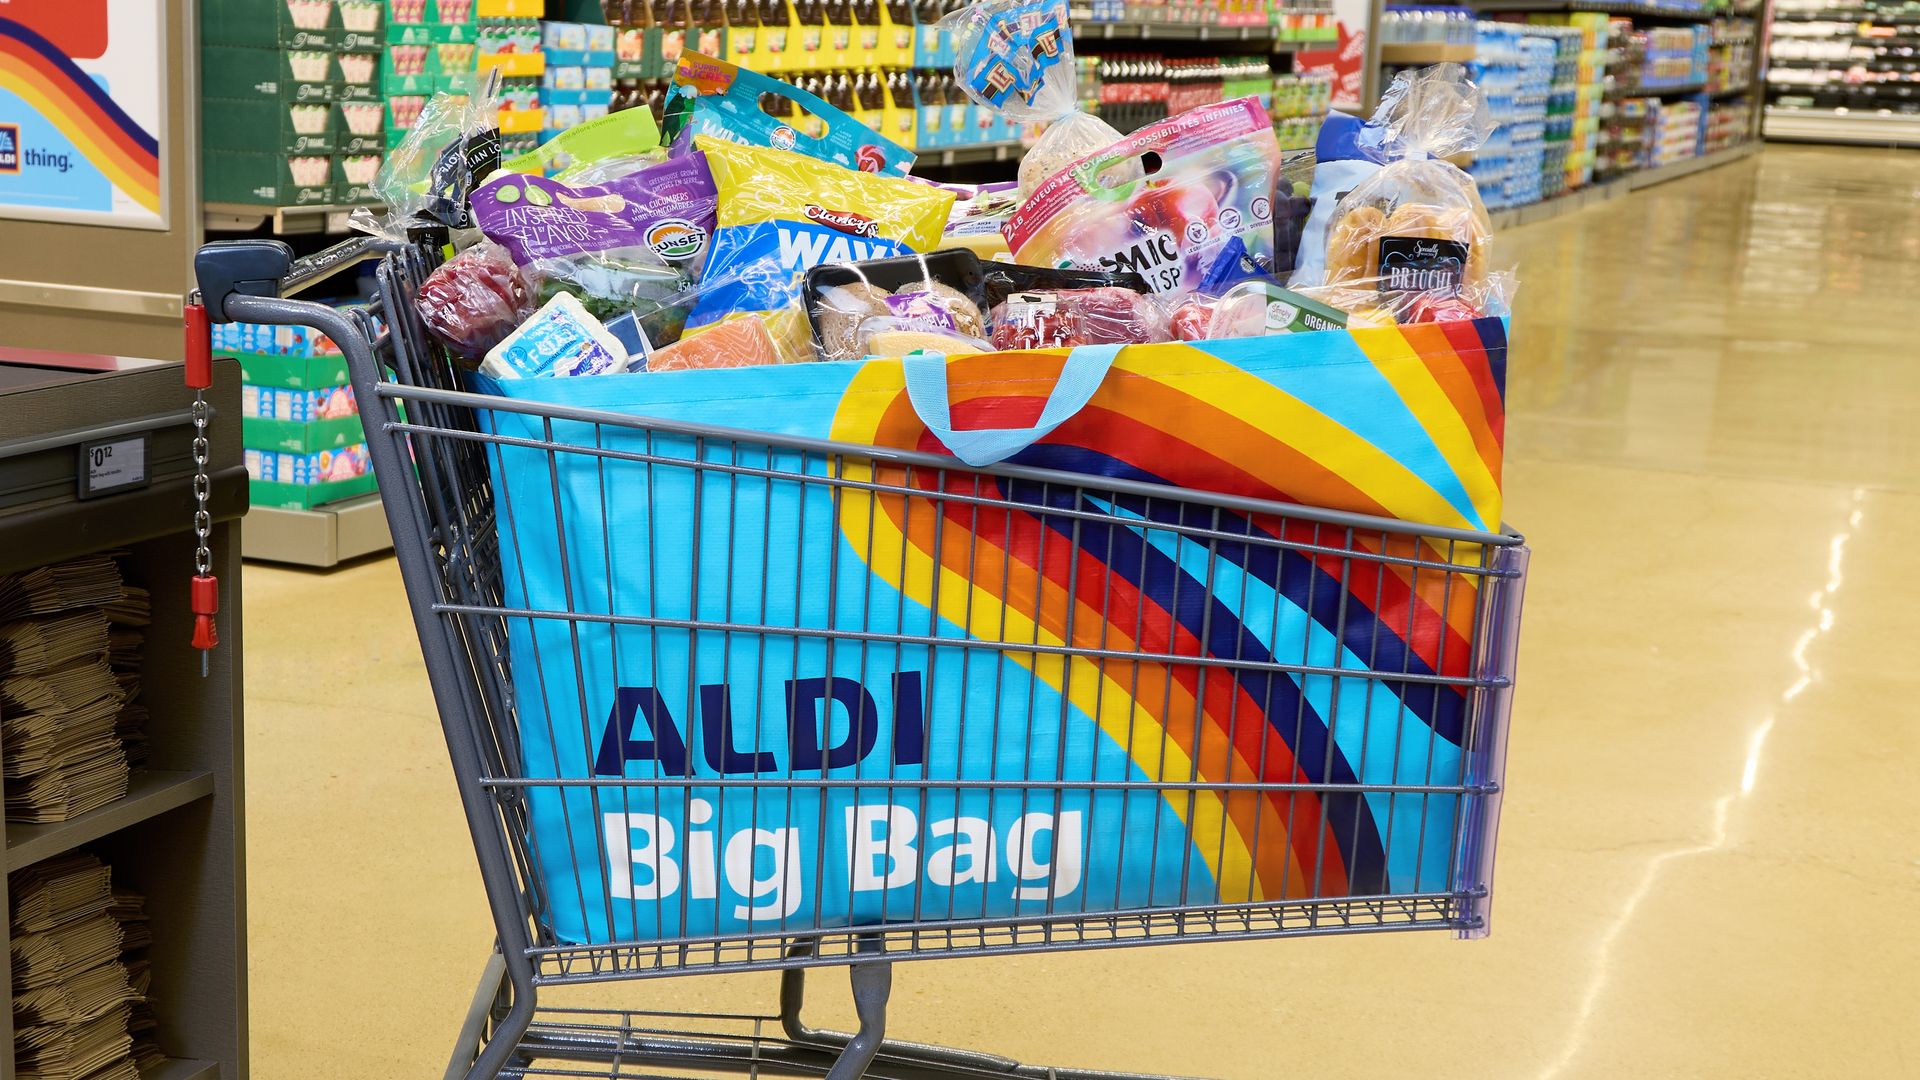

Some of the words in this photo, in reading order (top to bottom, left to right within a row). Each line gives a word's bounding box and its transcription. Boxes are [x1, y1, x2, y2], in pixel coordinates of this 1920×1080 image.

[0, 153, 17, 165] LDI
[24, 147, 74, 173] thing.
[467, 149, 489, 168] LIAN
[1026, 182, 1057, 212] SAVEUR
[1058, 150, 1120, 186] INCROYABLE
[1131, 118, 1200, 149] POSSIBILITÉS
[1202, 102, 1245, 123] INFINIES
[649, 192, 689, 210] CUCUMBERS
[505, 206, 588, 228] INSPIRED
[804, 204, 879, 238] Clancy's
[522, 224, 596, 246] FLAVOR
[650, 233, 706, 254] SUNSET
[1098, 234, 1178, 274] SMIC
[678, 281, 692, 293] 454
[1390, 266, 1454, 290] BRIOCHE
[1271, 303, 1292, 319] Simply
[534, 350, 561, 375] TRADITIONAL
[594, 670, 925, 776] ALDI
[603, 798, 802, 920] Big
[845, 803, 1084, 900] Bag
